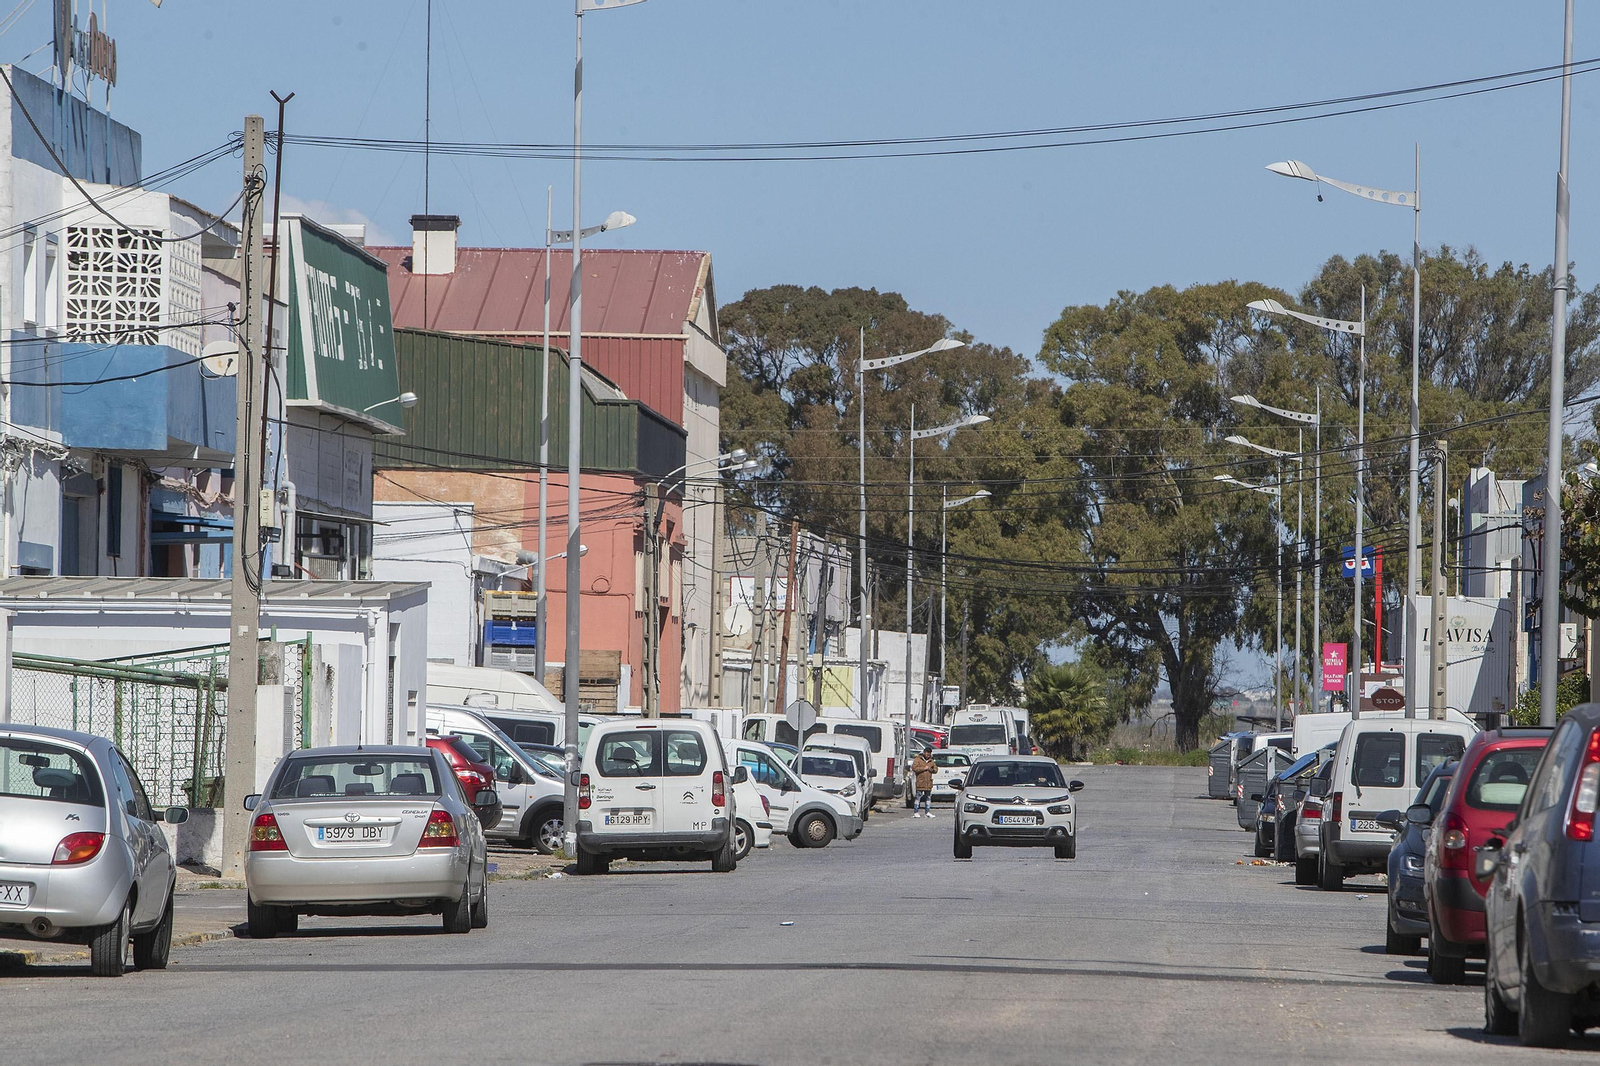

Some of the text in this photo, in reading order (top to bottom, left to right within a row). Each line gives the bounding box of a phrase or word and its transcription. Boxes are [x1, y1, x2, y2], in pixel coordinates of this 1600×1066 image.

[1422, 627, 1494, 643] IAVISA
[610, 816, 648, 824] 6129 HPY
[326, 826, 383, 839] 5979 DBY
